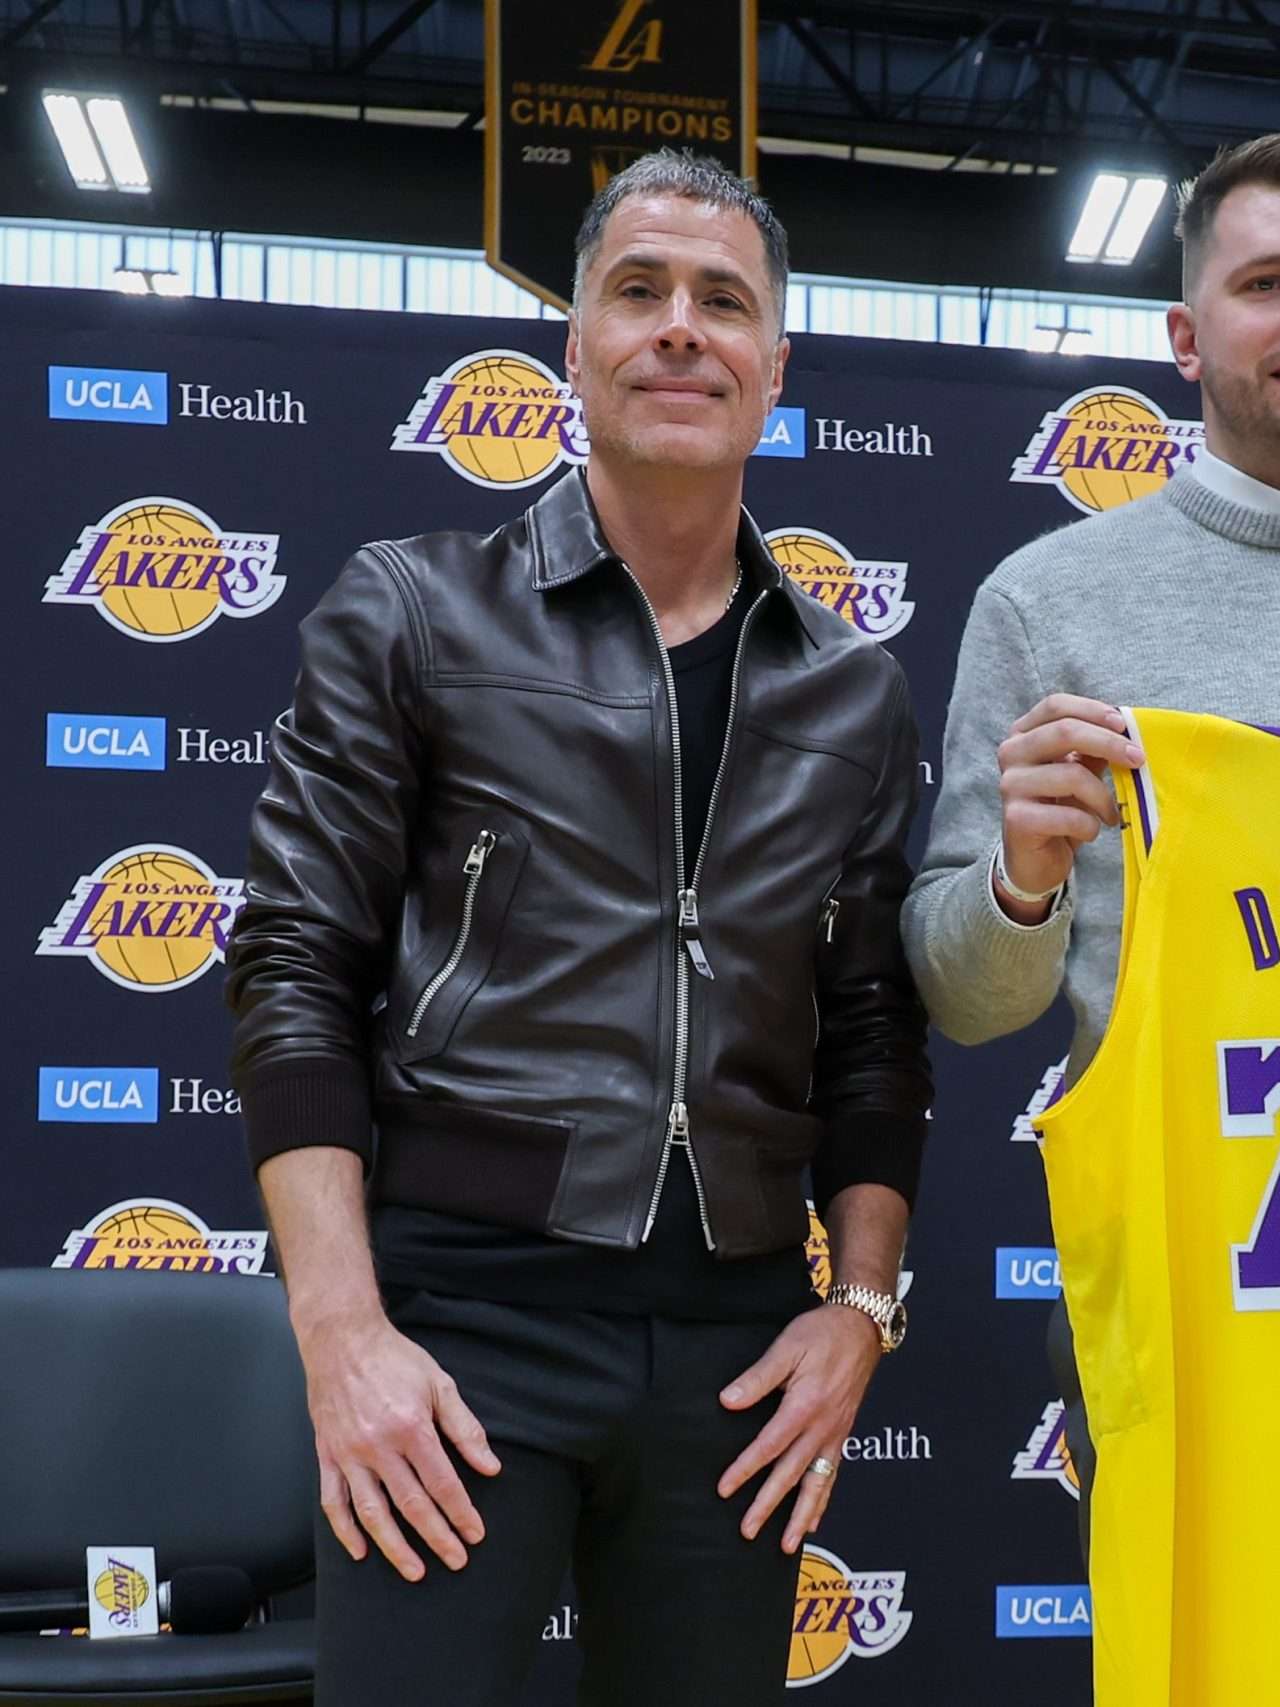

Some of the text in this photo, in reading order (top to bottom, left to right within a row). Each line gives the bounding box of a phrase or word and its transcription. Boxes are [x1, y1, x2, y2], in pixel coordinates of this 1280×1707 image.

[510, 99, 733, 141] CHAMPIONS
[521, 145, 571, 165] 2023
[65, 379, 308, 425] UCLA Health
[471, 385, 576, 399] LOS ANGE
[815, 418, 934, 457] Health
[1085, 419, 1120, 432] LOS
[127, 534, 270, 552] LOS ANGELES
[60, 532, 277, 609] LAKERS
[781, 563, 898, 579] OS ANGELES
[63, 726, 268, 764] UCLA Heal
[122, 882, 240, 897] LOS ANGEL
[55, 1077, 242, 1115] UCLA Hea
[114, 1237, 258, 1250] LOS ANGELES
[1010, 1259, 1063, 1286] UCL
[841, 1426, 932, 1461] ealth
[107, 1554, 136, 1628] LAKERS
[802, 1578, 896, 1592] ANGELES
[1010, 1597, 1089, 1624] UCLA
